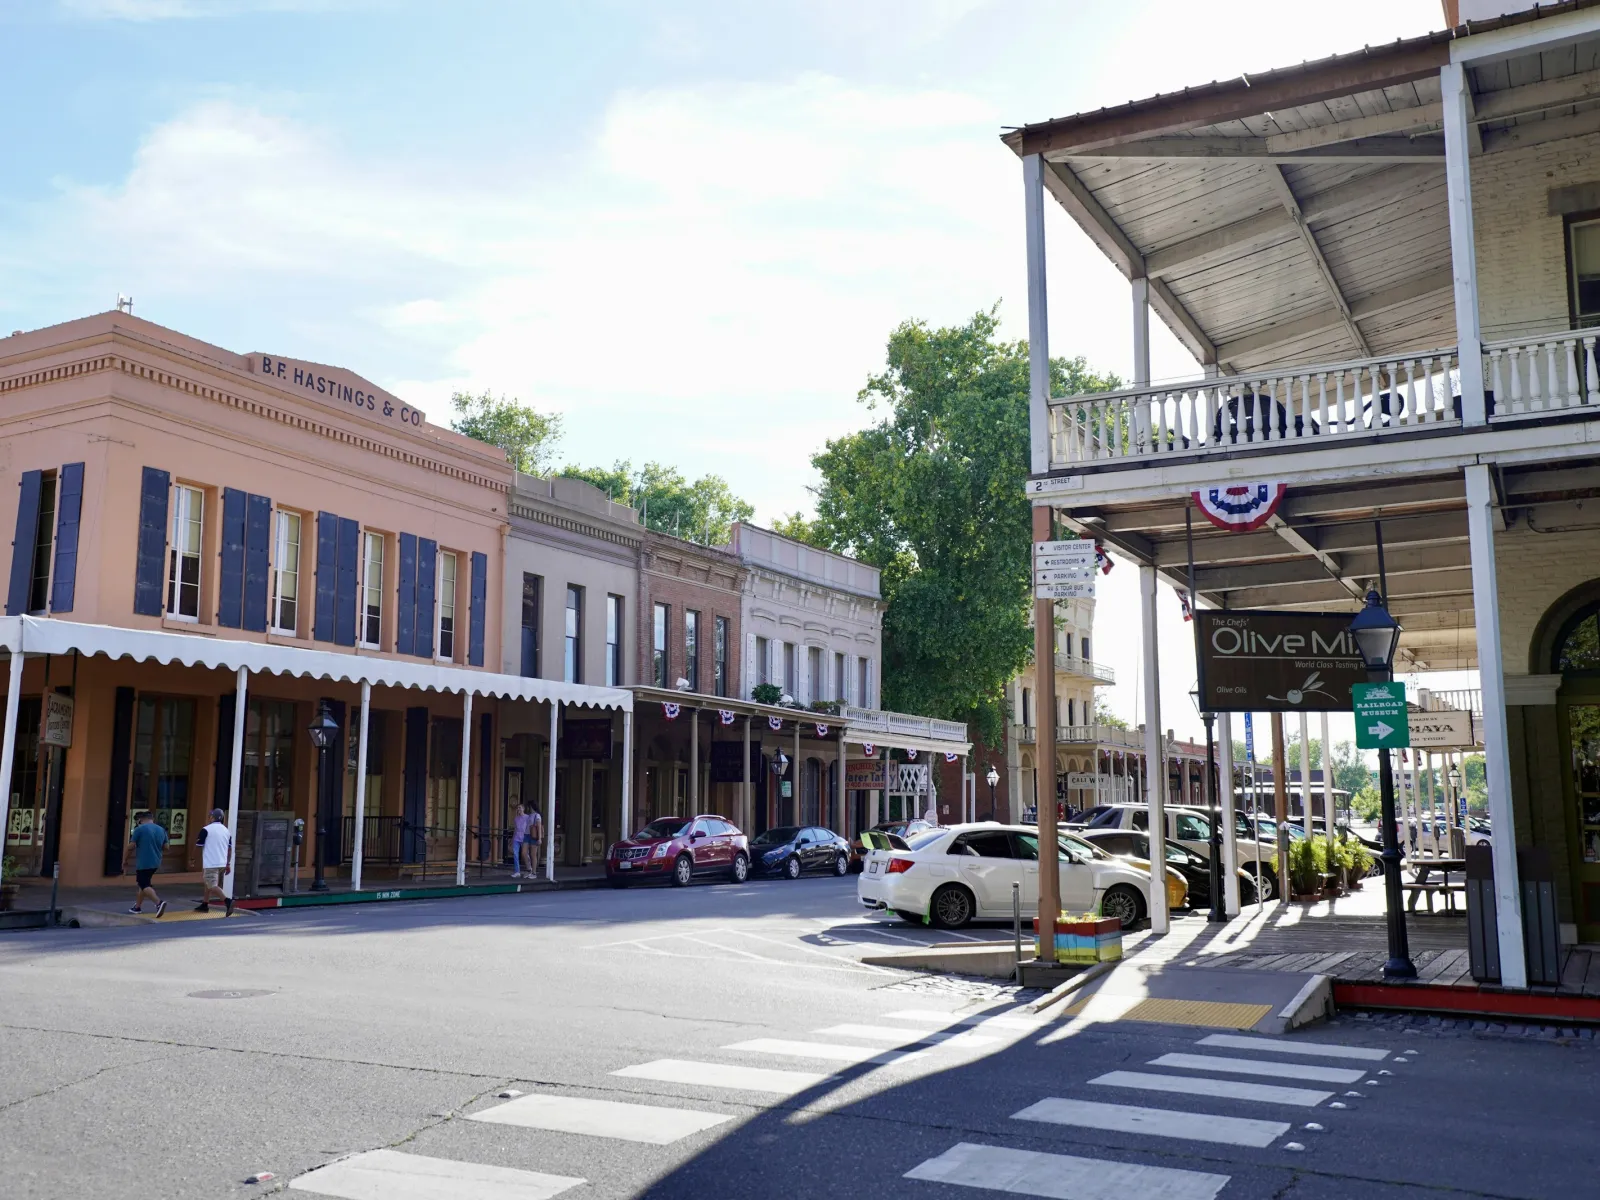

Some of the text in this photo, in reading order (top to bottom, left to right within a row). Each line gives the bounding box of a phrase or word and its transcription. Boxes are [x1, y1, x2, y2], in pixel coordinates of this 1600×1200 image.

[262, 356, 423, 428] B.F. HASTINGS & CO.
[1050, 477, 1071, 485] STREET
[1212, 618, 1250, 628] The Chefs'
[1211, 627, 1361, 655] Olive Mi
[1294, 661, 1315, 669] World
[1316, 661, 1333, 669] Class
[1335, 661, 1358, 670] Tasting
[1216, 686, 1247, 694] Olive Oils
[1356, 701, 1404, 709] RAILROAD
[845, 772, 896, 787] ater Tafy
[390, 890, 400, 898] ZONE
